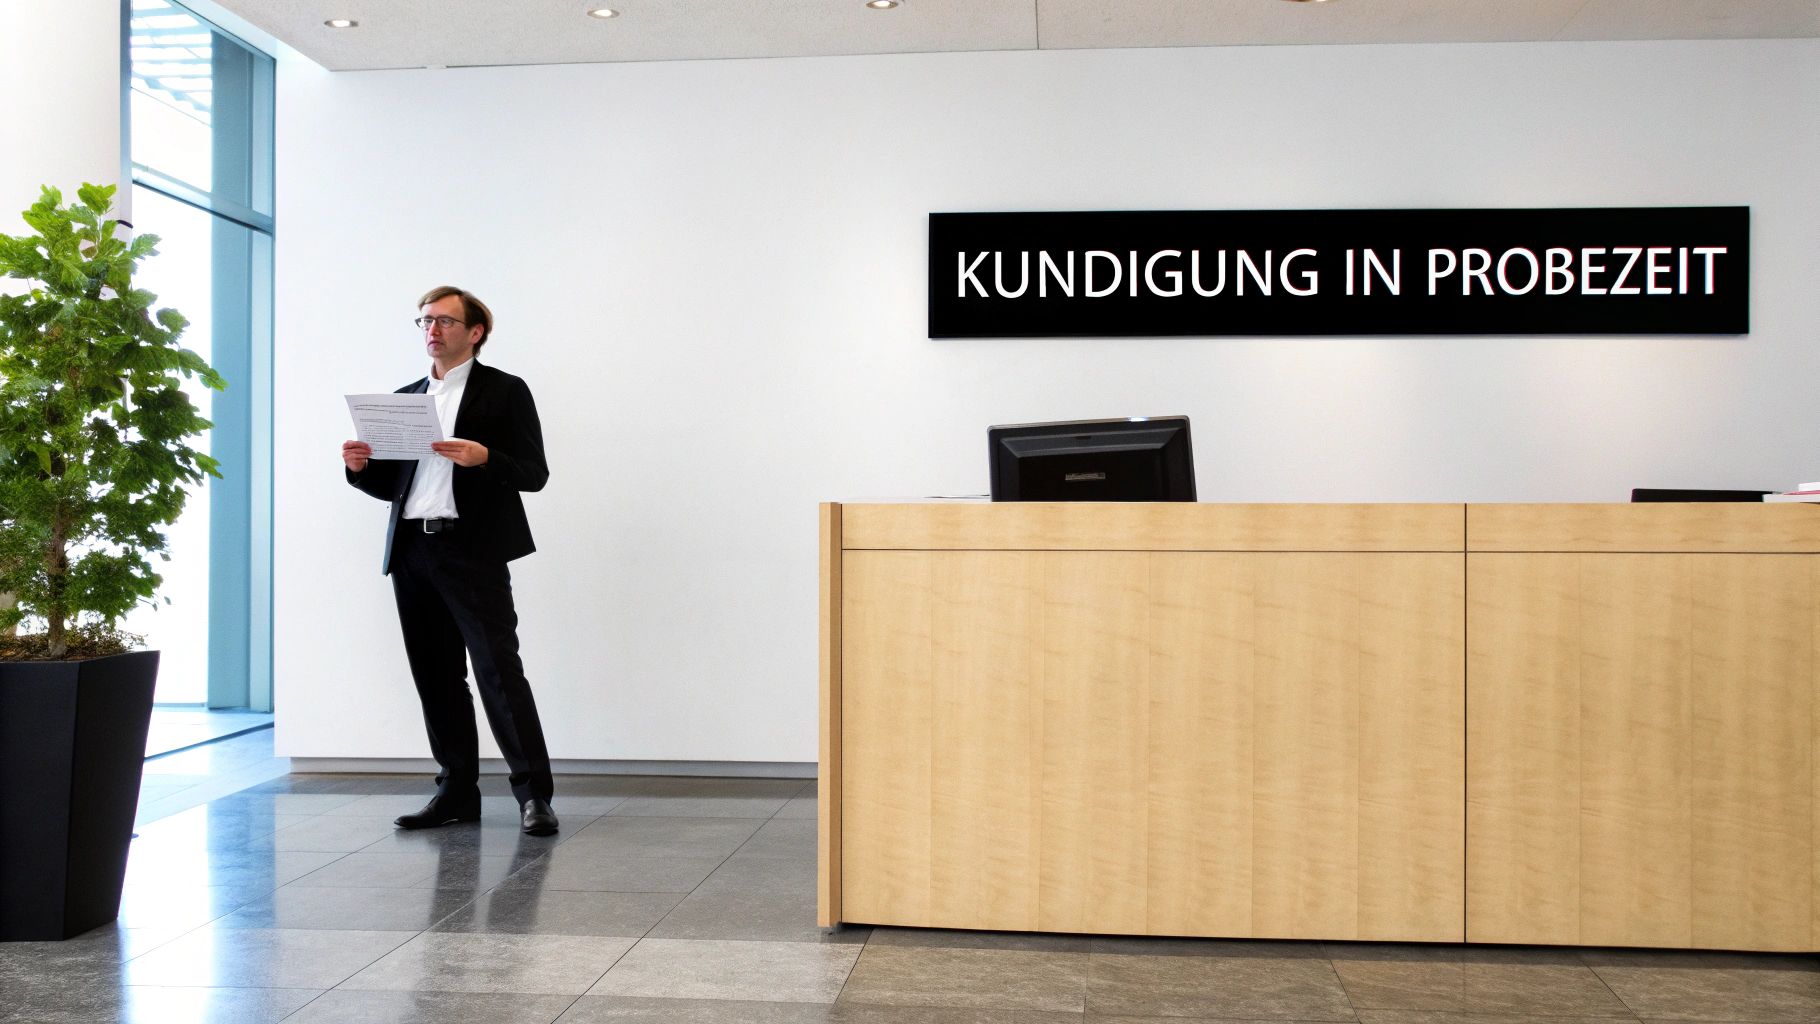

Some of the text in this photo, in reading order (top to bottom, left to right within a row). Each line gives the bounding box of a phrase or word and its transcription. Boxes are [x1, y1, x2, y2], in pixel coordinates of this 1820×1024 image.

[958, 247, 1728, 299] KUNDIGUNG IN PROBEZEIT
